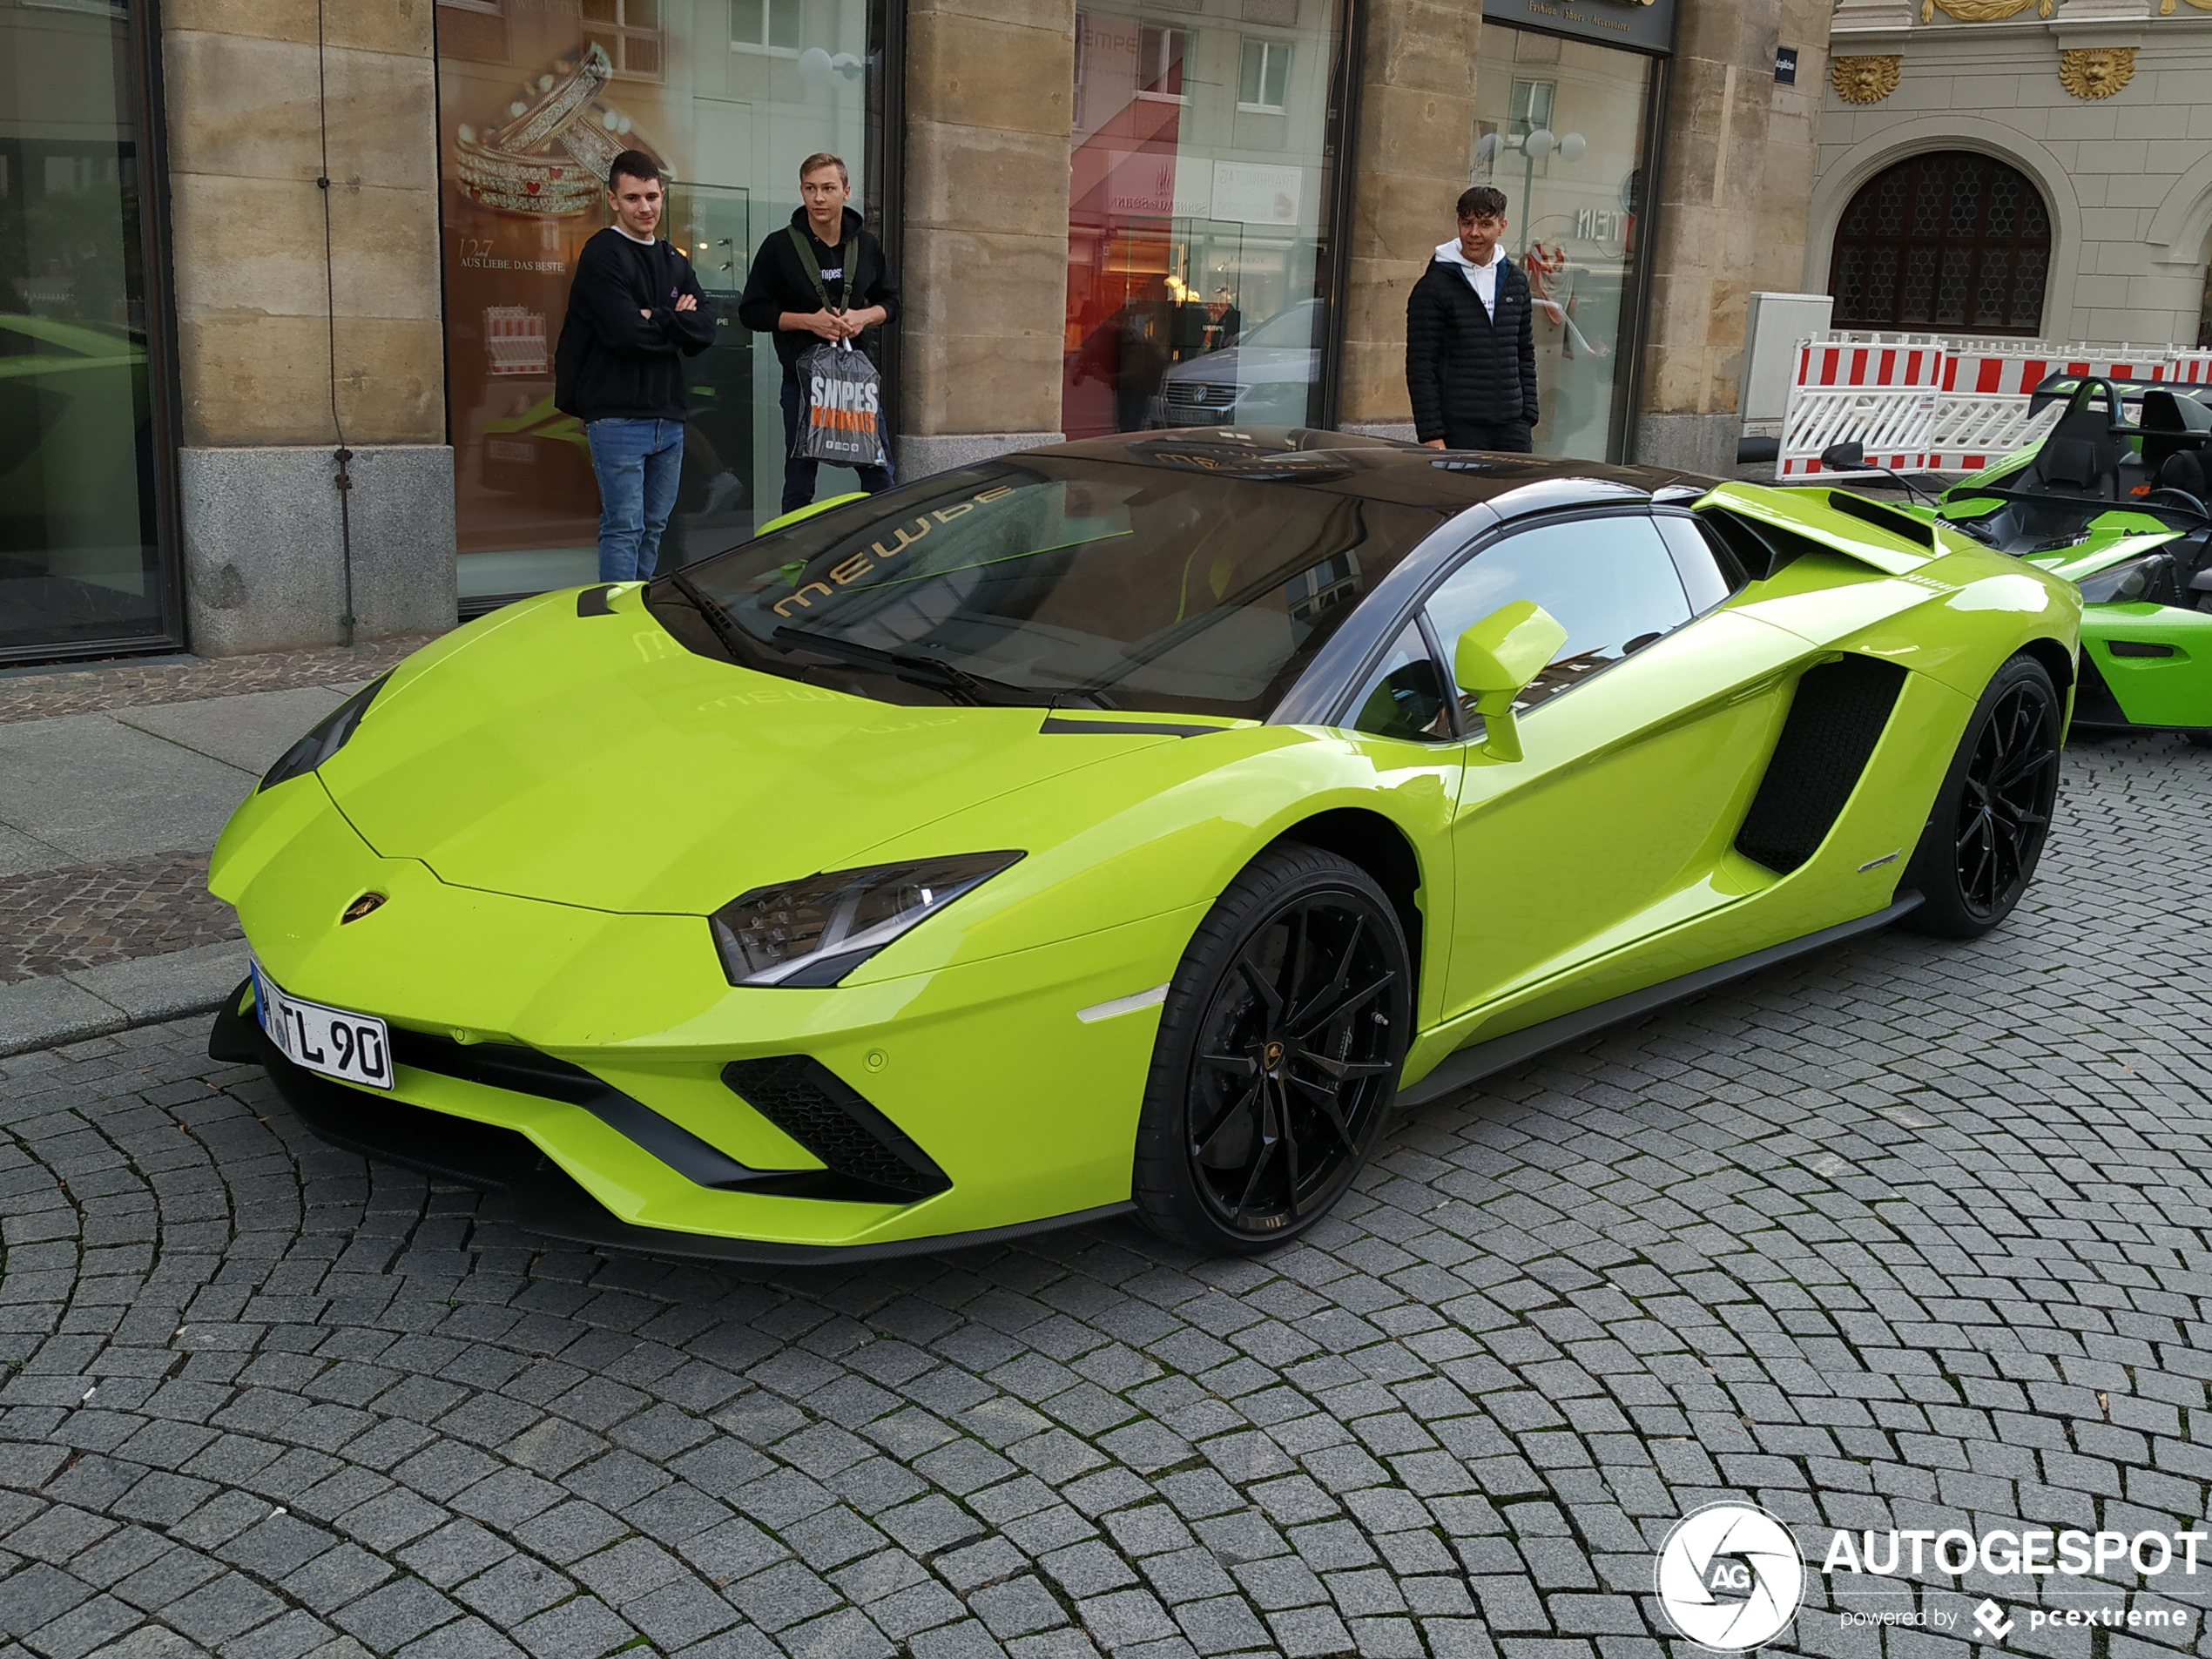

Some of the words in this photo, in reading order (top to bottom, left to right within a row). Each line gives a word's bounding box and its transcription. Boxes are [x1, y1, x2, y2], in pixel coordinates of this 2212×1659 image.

[1528, 0, 1556, 16] Fashion
[1564, 8, 1584, 22] Shoes
[460, 259, 480, 267] AUS
[482, 260, 512, 269] LIEBE.
[514, 261, 534, 270] DAS
[536, 262, 565, 272] BESTE.
[820, 268, 842, 281] nipes
[811, 376, 878, 414] SNIPES
[279, 1001, 325, 1064] TL
[331, 1020, 385, 1079] 90
